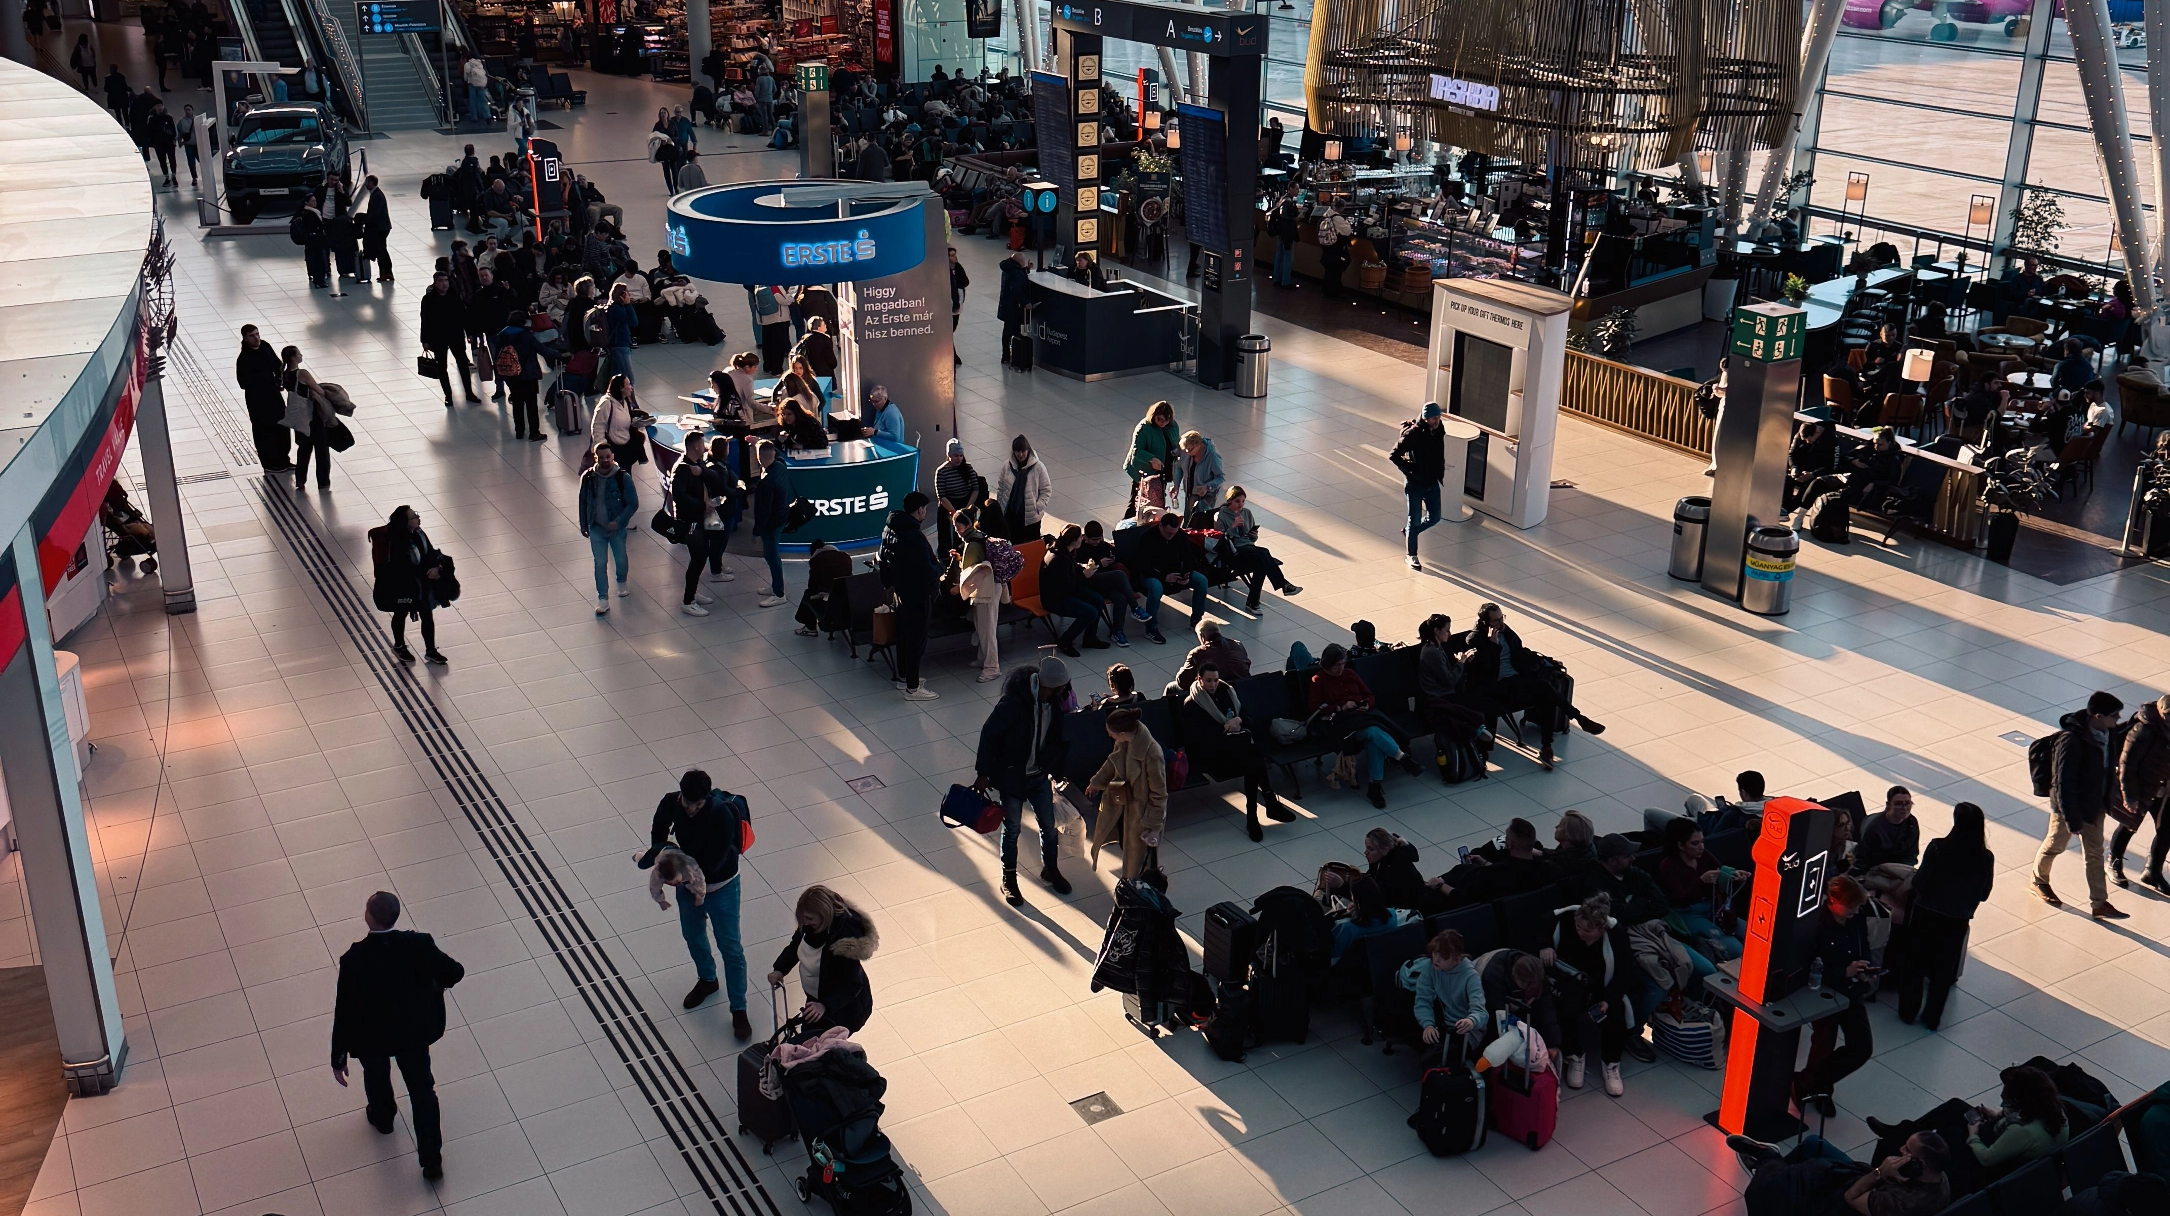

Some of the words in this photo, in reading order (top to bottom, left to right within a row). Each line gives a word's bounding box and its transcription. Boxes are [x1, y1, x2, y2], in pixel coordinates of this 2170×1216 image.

[1094, 8, 1102, 25] B
[1166, 20, 1176, 38] A
[784, 242, 853, 266] ERSTE
[863, 286, 896, 299] Higgy
[864, 297, 926, 312] magadban!
[865, 315, 880, 326] Az
[882, 313, 911, 324] Erste
[913, 310, 934, 321] már
[1450, 300, 1460, 310] PICK
[1460, 304, 1468, 313] UP
[1468, 306, 1480, 317] YOUR
[1480, 309, 1490, 320] GIFT
[1490, 312, 1511, 327] THERMOS
[1511, 319, 1525, 331] HERE
[865, 329, 888, 340] hisz
[890, 324, 934, 337] benned.
[808, 496, 867, 516] RSTE
[1784, 857, 1800, 871] bud
